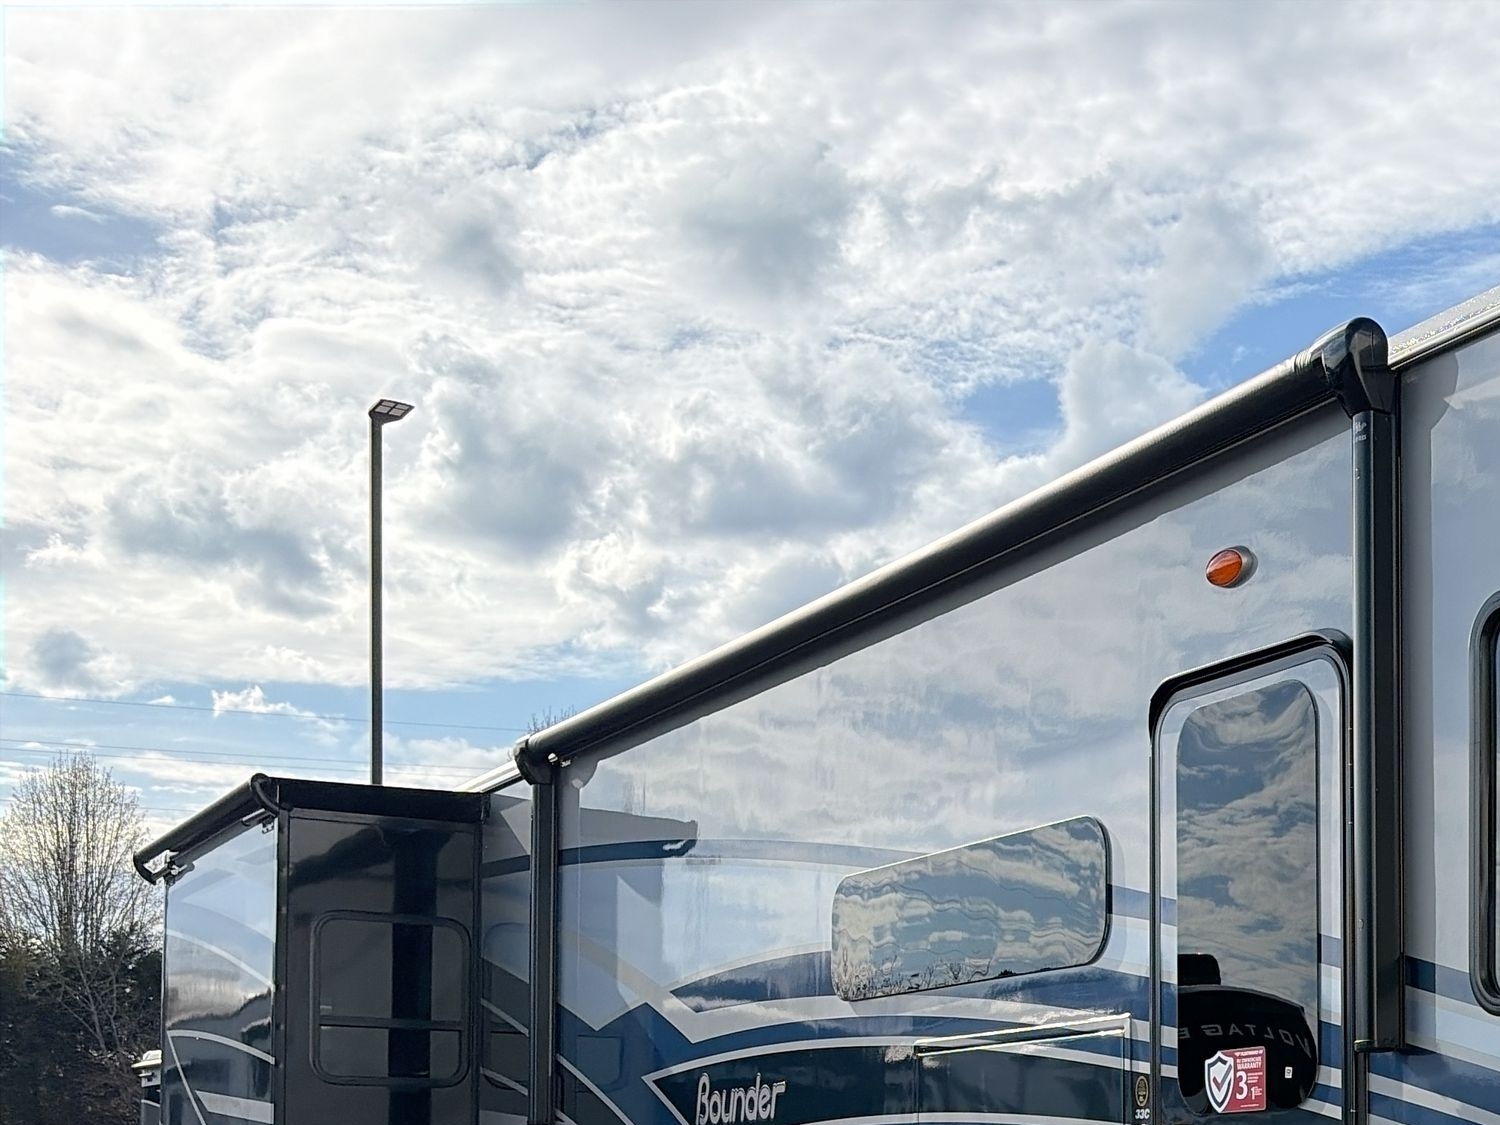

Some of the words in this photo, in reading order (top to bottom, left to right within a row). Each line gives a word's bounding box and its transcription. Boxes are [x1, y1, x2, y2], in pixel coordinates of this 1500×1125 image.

[695, 1072, 787, 1125] Bounder
[1235, 1071, 1249, 1100] 3
[1134, 1108, 1151, 1120] 33C
